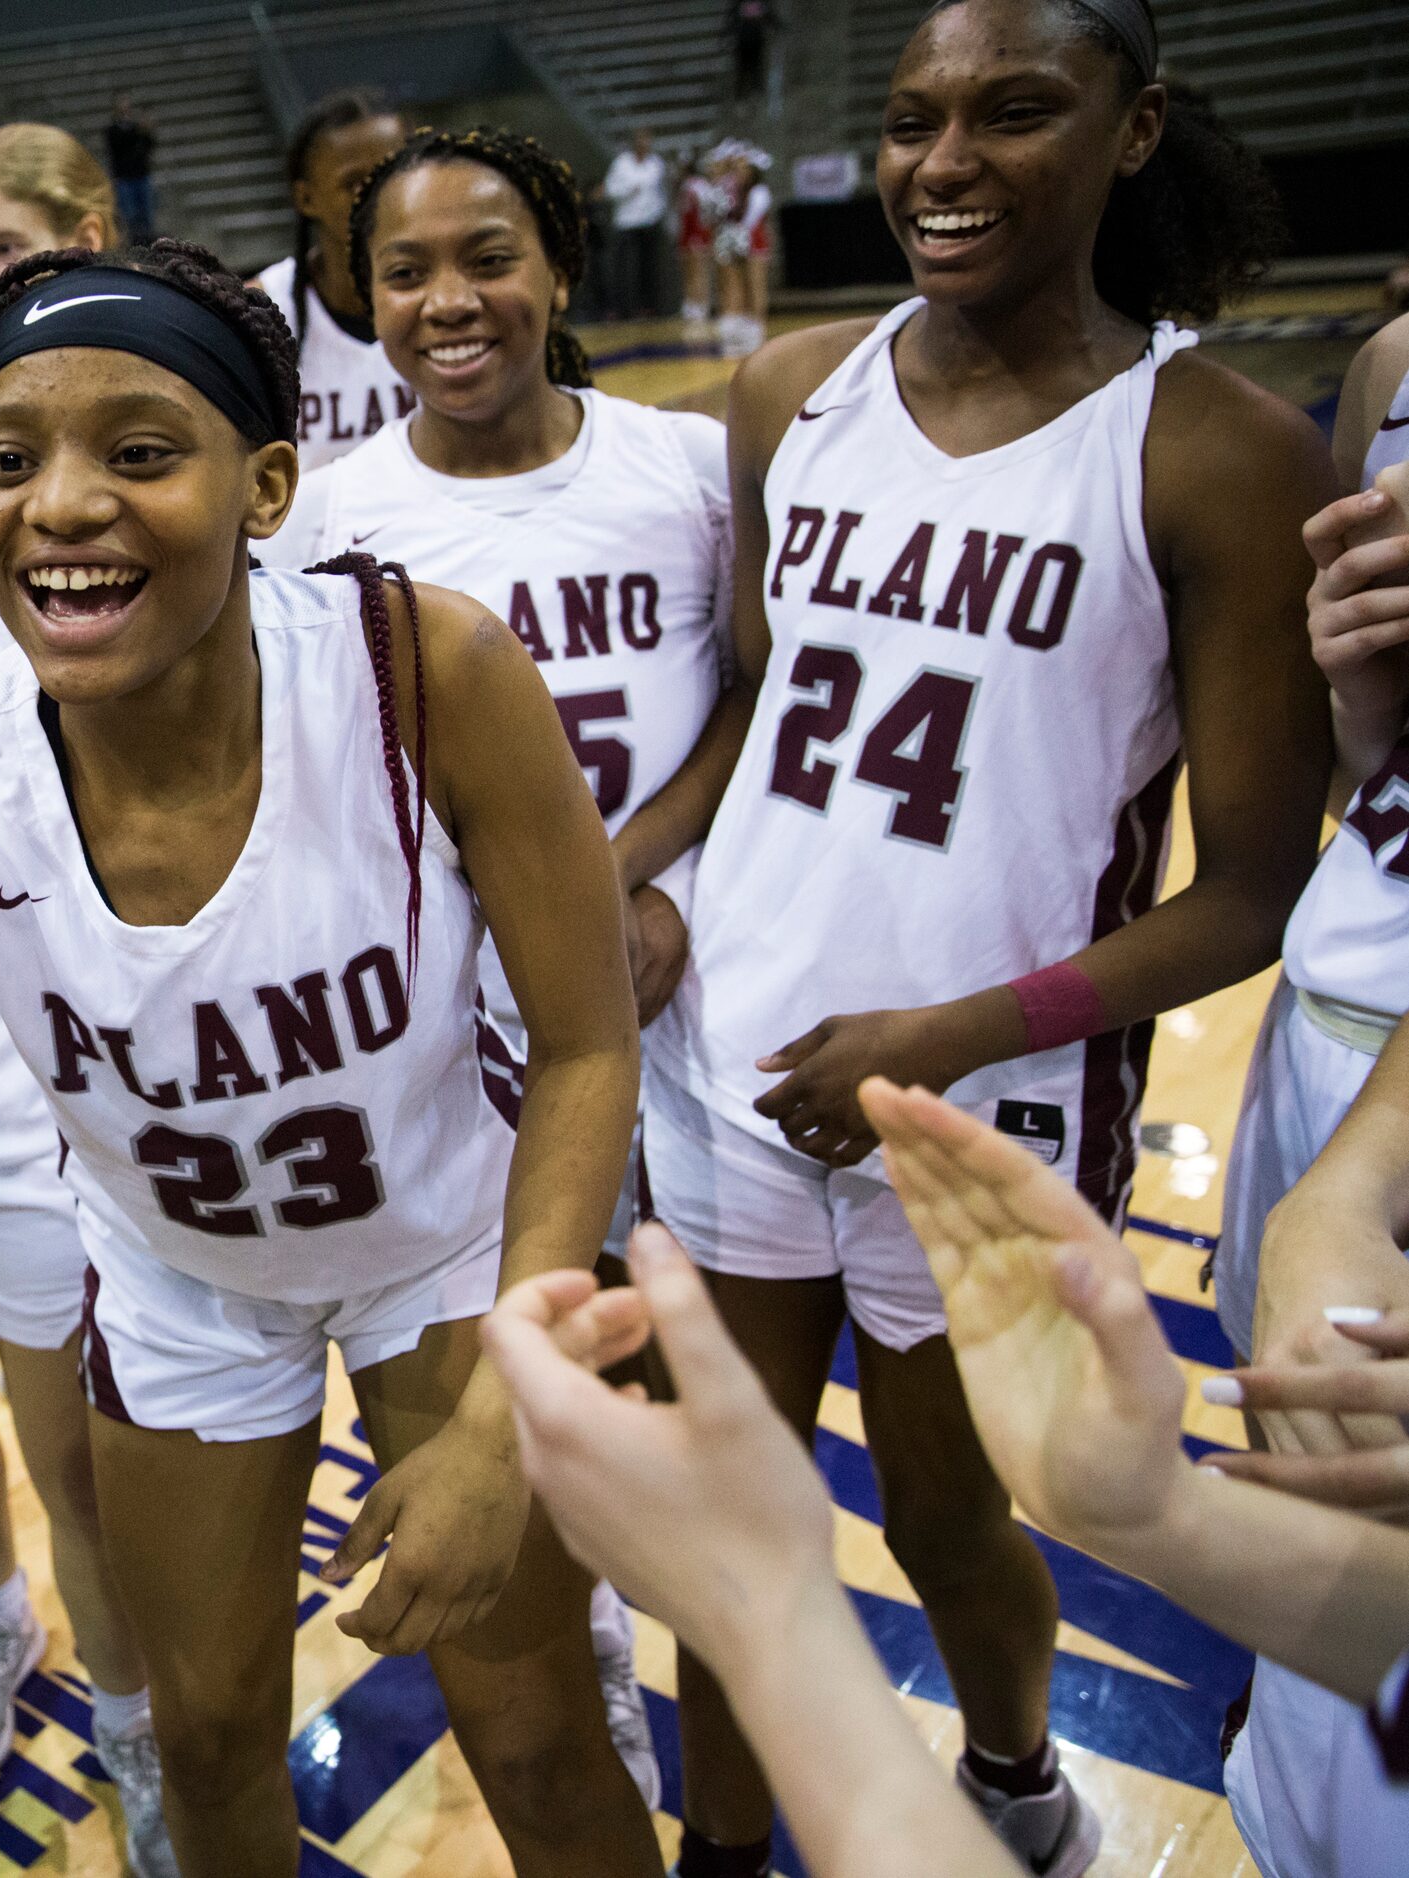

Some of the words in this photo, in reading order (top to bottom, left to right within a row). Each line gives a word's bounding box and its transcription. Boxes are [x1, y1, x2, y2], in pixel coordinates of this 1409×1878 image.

[298, 384, 417, 441] PLAN
[509, 573, 662, 662] ANO
[769, 504, 1086, 652] PLANO
[553, 683, 635, 822] 5
[766, 639, 983, 855] 24
[41, 942, 410, 1110] PLANO
[129, 1100, 387, 1238] 23
[1022, 1110, 1040, 1131] L
